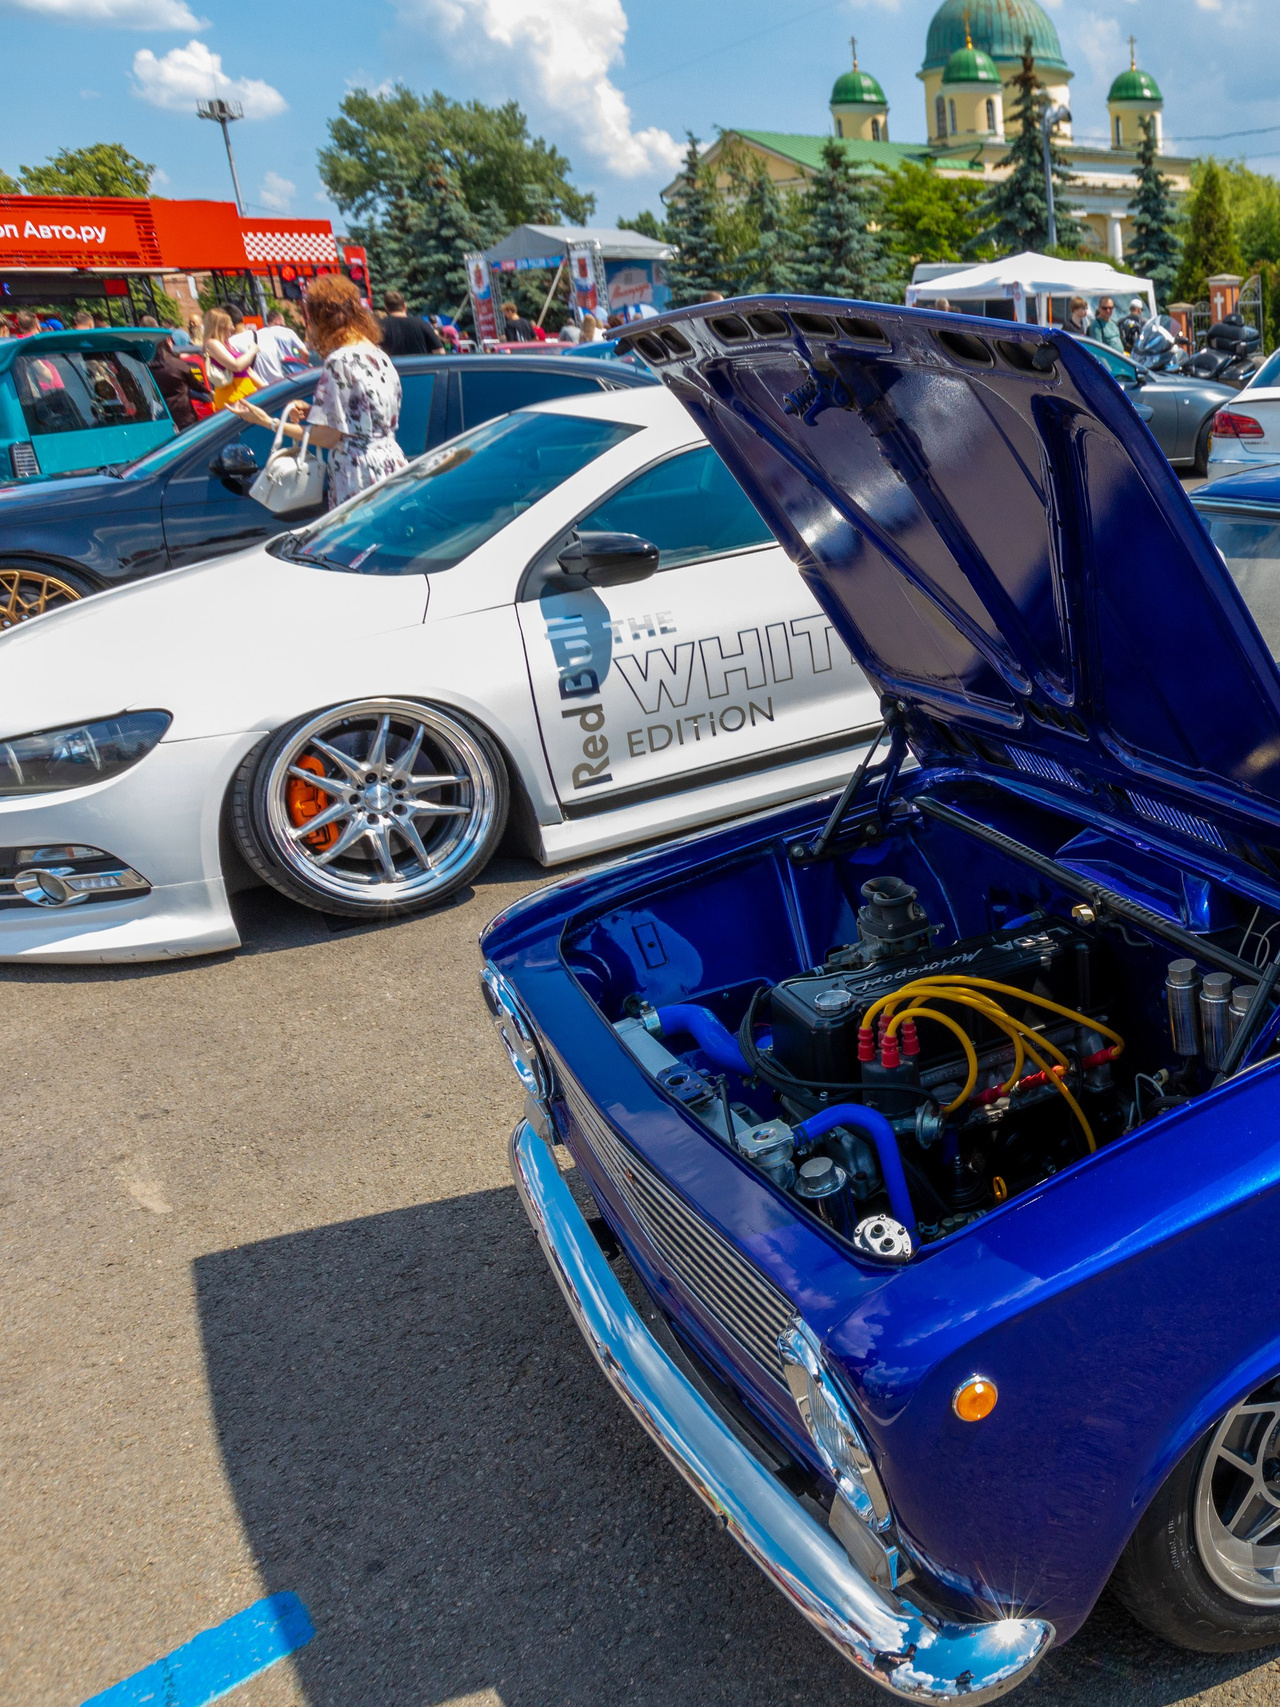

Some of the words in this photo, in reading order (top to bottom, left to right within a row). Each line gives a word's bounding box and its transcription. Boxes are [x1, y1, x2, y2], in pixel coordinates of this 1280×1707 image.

[23, 220, 107, 244] Авто.ру
[602, 610, 677, 644] THE
[544, 613, 600, 700] Bull
[613, 613, 857, 715] WHIT
[561, 703, 613, 790] Red
[992, 926, 1073, 951] LADA
[854, 948, 983, 991] Motorsport
